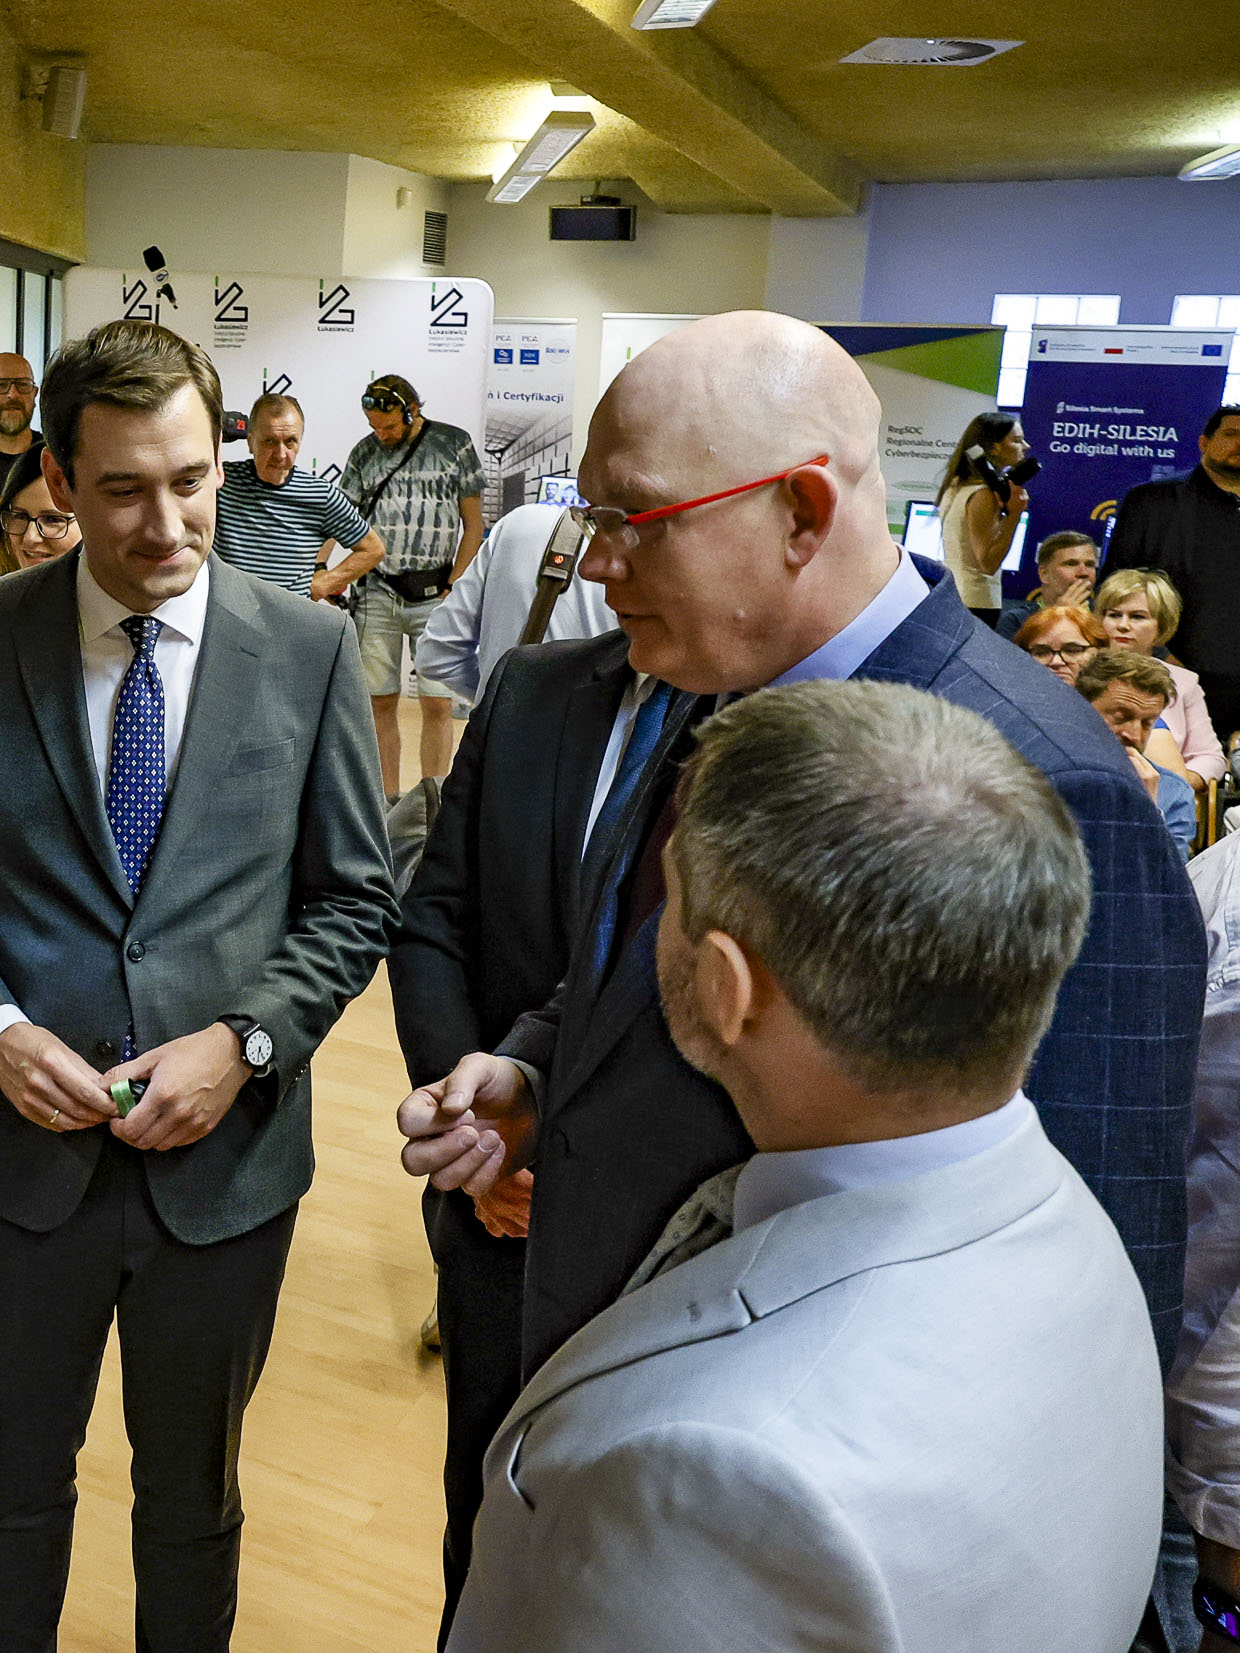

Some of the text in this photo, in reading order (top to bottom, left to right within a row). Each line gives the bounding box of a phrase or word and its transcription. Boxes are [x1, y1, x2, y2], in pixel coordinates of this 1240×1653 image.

[503, 391, 564, 404] Certyfikacji
[1052, 422, 1179, 442] EDIH-SILESIA
[887, 437, 933, 447] Regionalne
[1049, 441, 1176, 459] Go digital with us
